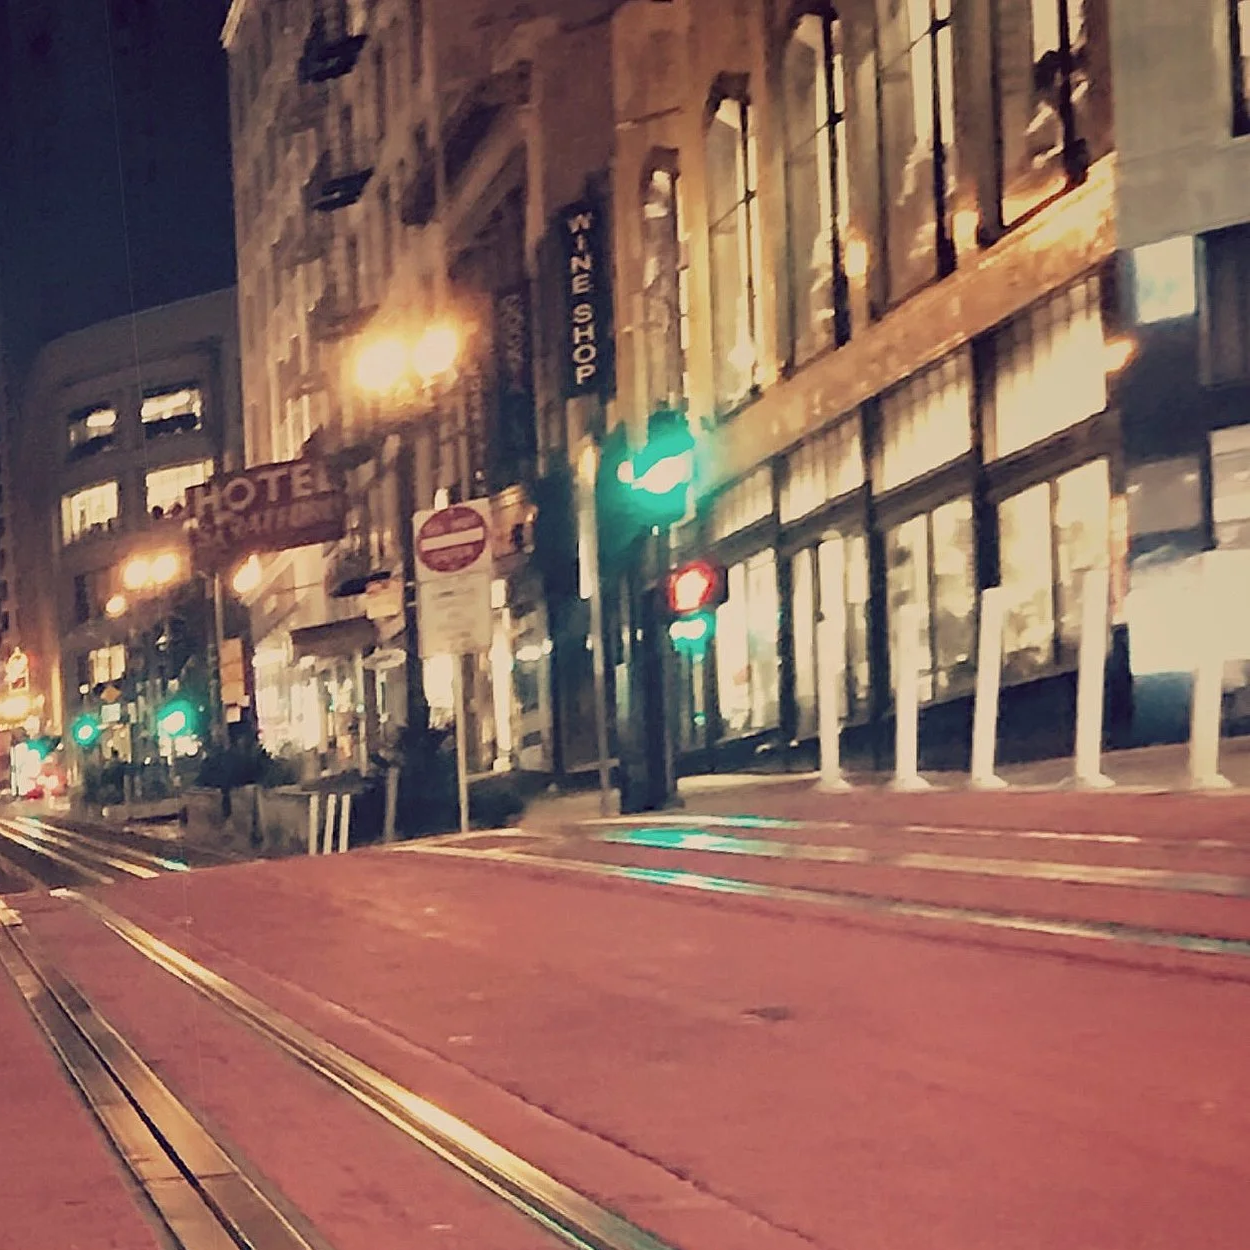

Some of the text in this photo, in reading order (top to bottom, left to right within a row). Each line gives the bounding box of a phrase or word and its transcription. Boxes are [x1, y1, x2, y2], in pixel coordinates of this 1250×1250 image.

[567, 211, 597, 386] WINE SHOP
[194, 460, 332, 520] HOTEL
